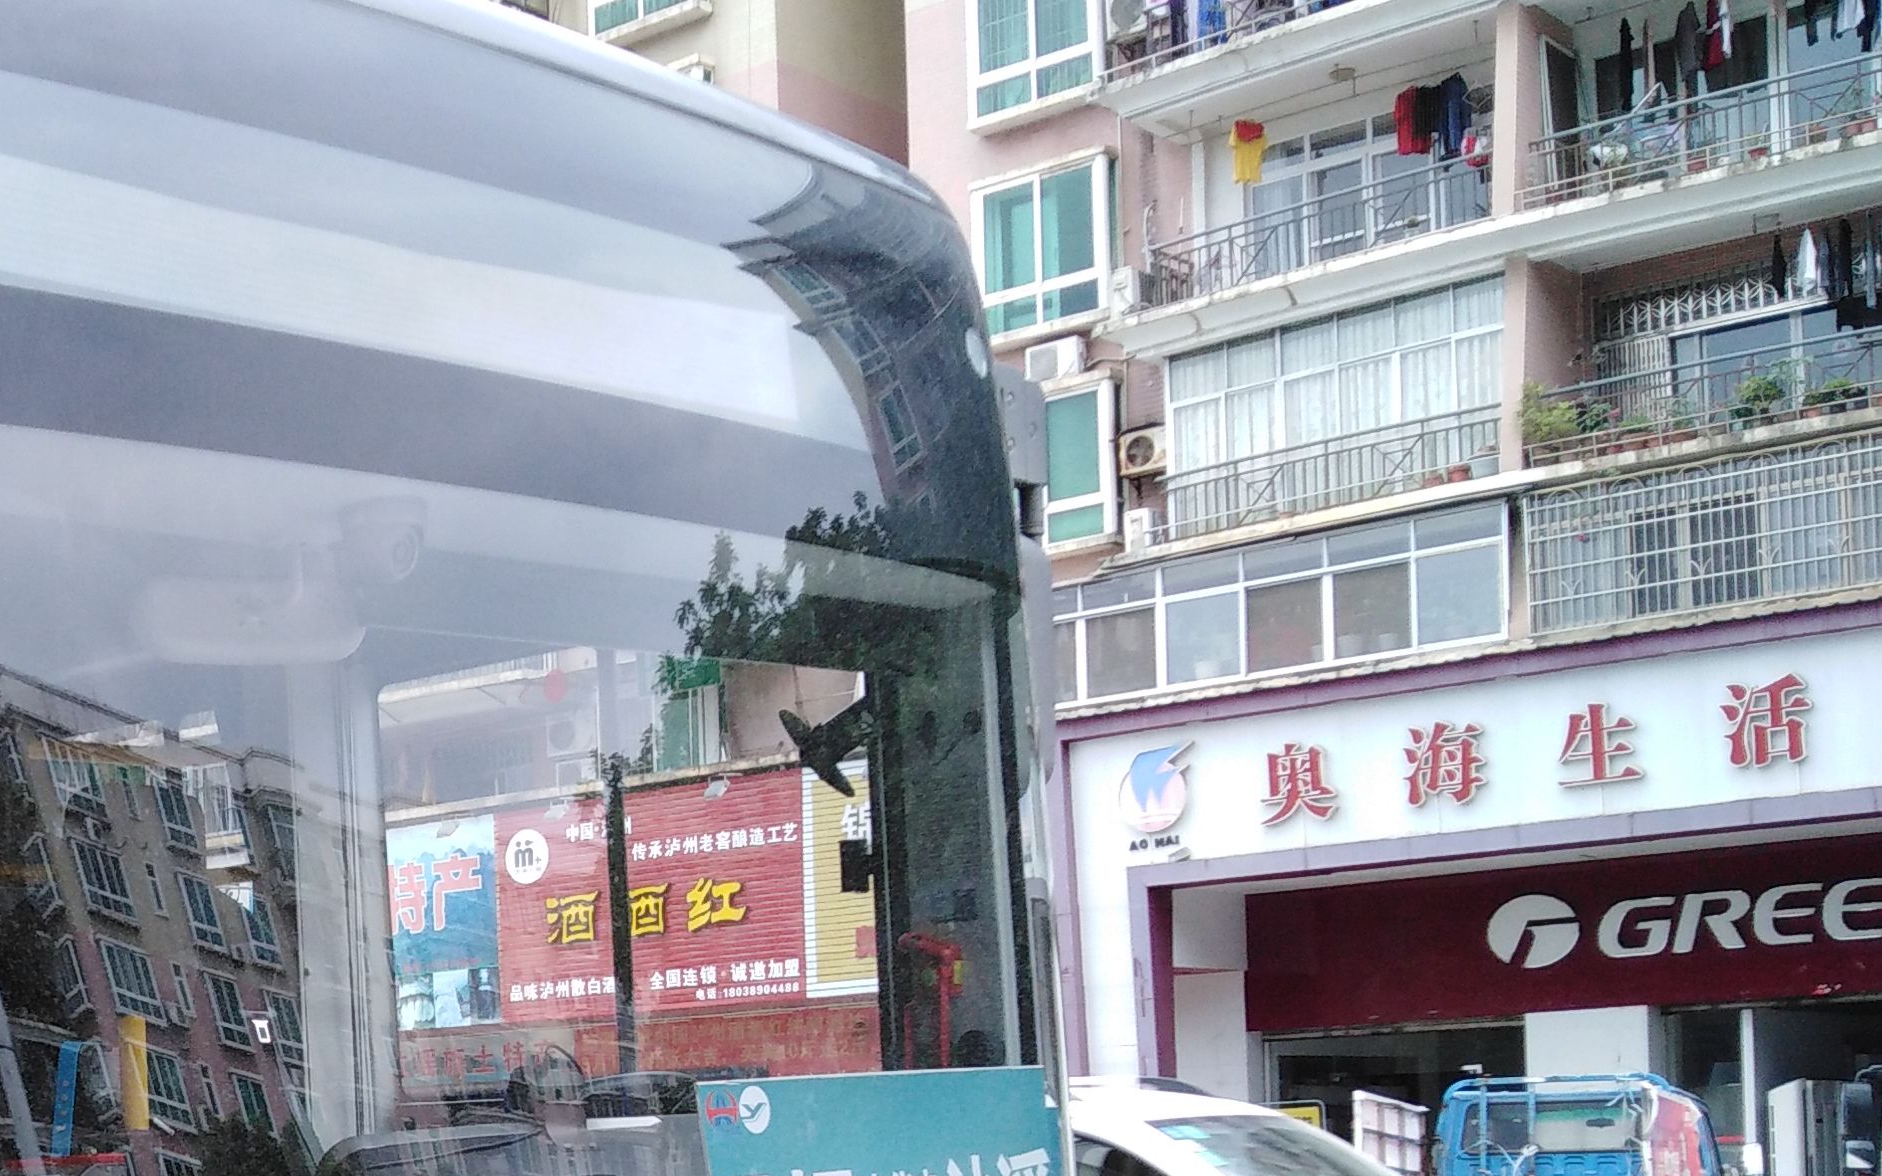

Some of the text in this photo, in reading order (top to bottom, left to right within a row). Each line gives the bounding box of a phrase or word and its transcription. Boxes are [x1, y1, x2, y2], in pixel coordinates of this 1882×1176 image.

[1261, 673, 1813, 828] 奥海生活
[631, 822, 798, 862] 传承泸州老窖酿造工艺
[1596, 876, 1882, 961] GREE
[509, 975, 617, 1003] 品味泸州散白酒
